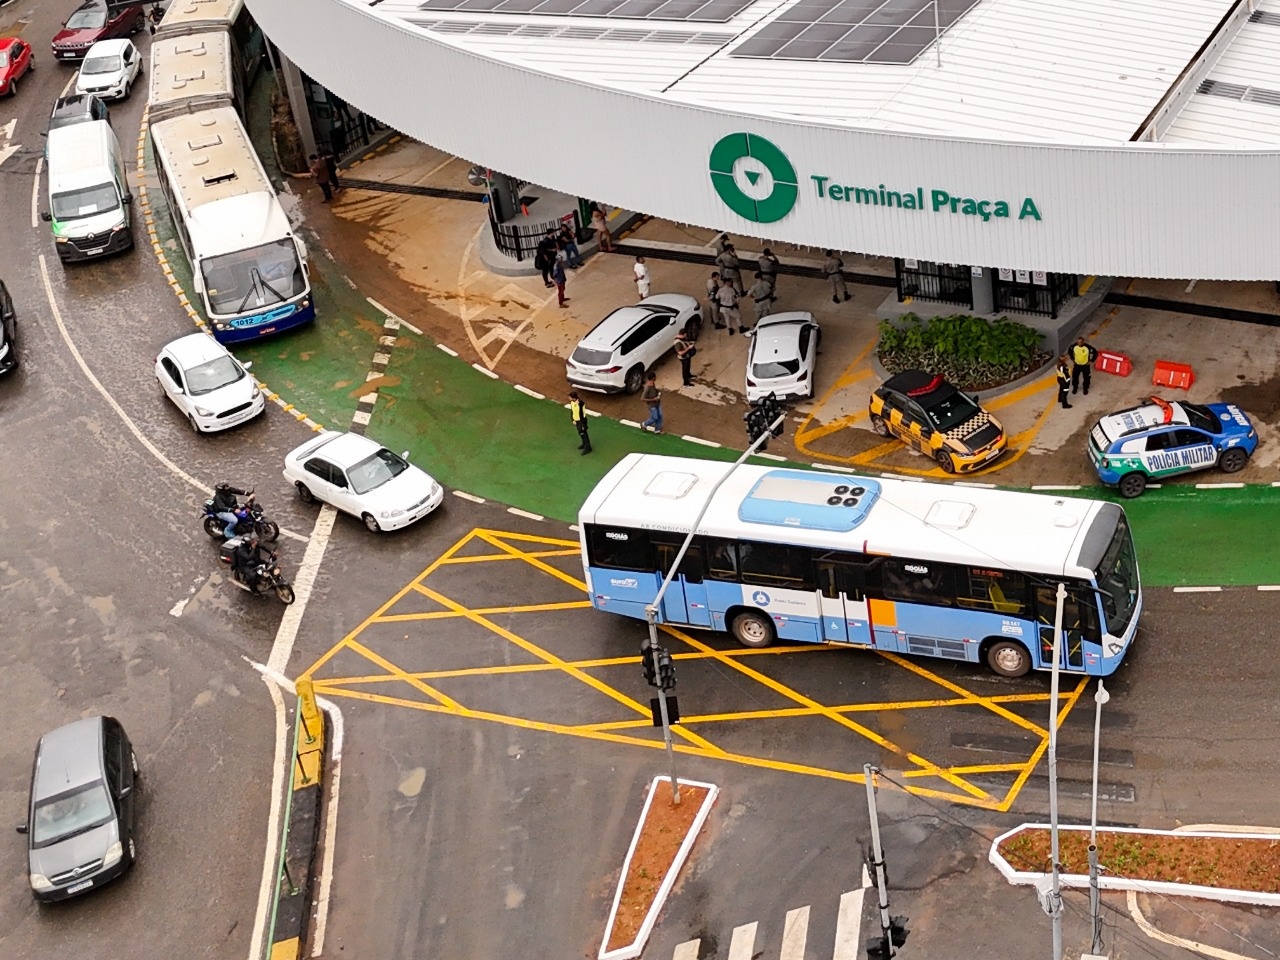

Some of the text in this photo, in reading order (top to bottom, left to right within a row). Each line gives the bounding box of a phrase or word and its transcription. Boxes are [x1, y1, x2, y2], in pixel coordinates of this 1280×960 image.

[810, 175, 1041, 221] Terminal Praça A
[235, 318, 254, 327] 1012
[1147, 445, 1214, 471] POLÍCIA MILITAR
